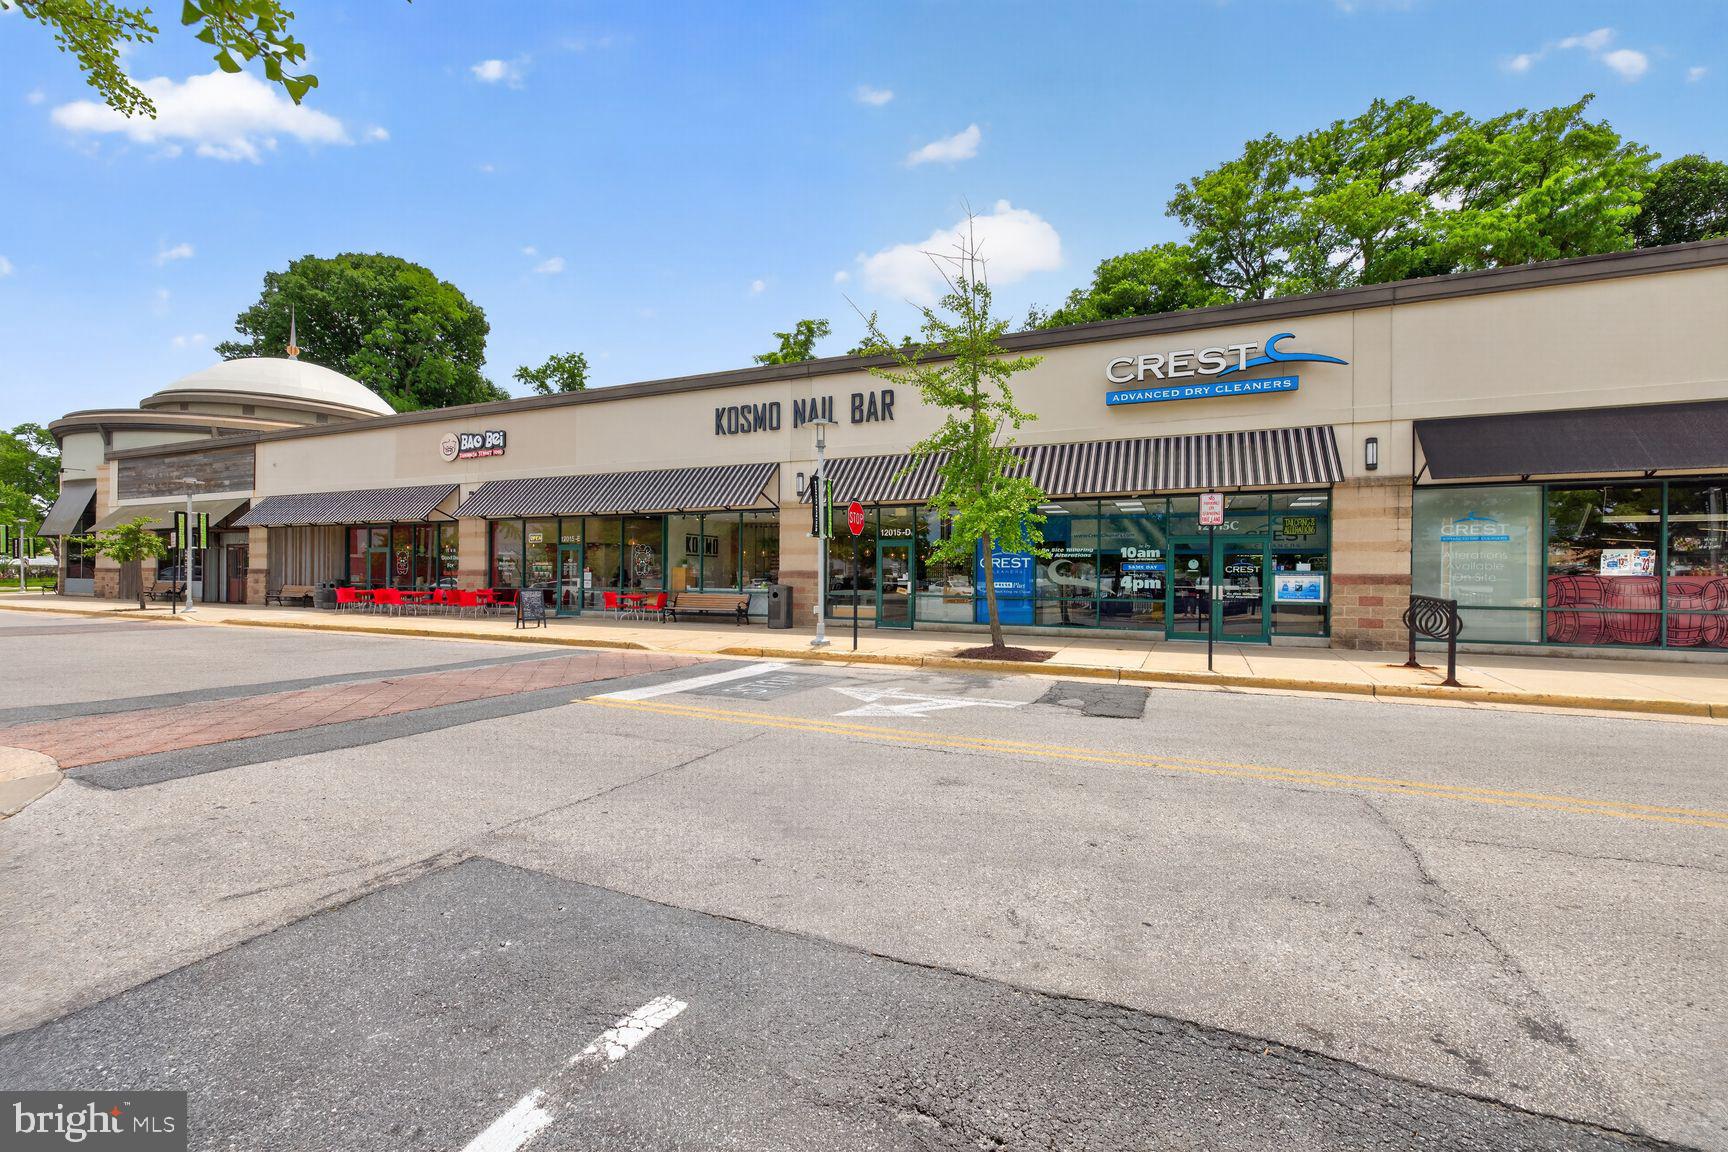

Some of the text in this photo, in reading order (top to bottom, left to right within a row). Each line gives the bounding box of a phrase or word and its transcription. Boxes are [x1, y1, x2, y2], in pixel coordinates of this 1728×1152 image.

[1105, 341, 1258, 384] CREST
[1112, 379, 1292, 402] ADVANCED DRY CLEANERS
[715, 389, 895, 435] KOSMO NAIL BAR
[461, 434, 482, 450] BAO
[849, 511, 864, 525] STOP
[1440, 524, 1510, 535] CREST
[685, 536, 719, 555] KOMO
[1120, 546, 1161, 558] 10am
[1225, 565, 1260, 573] CREST
[1120, 575, 1162, 592] 4pm
